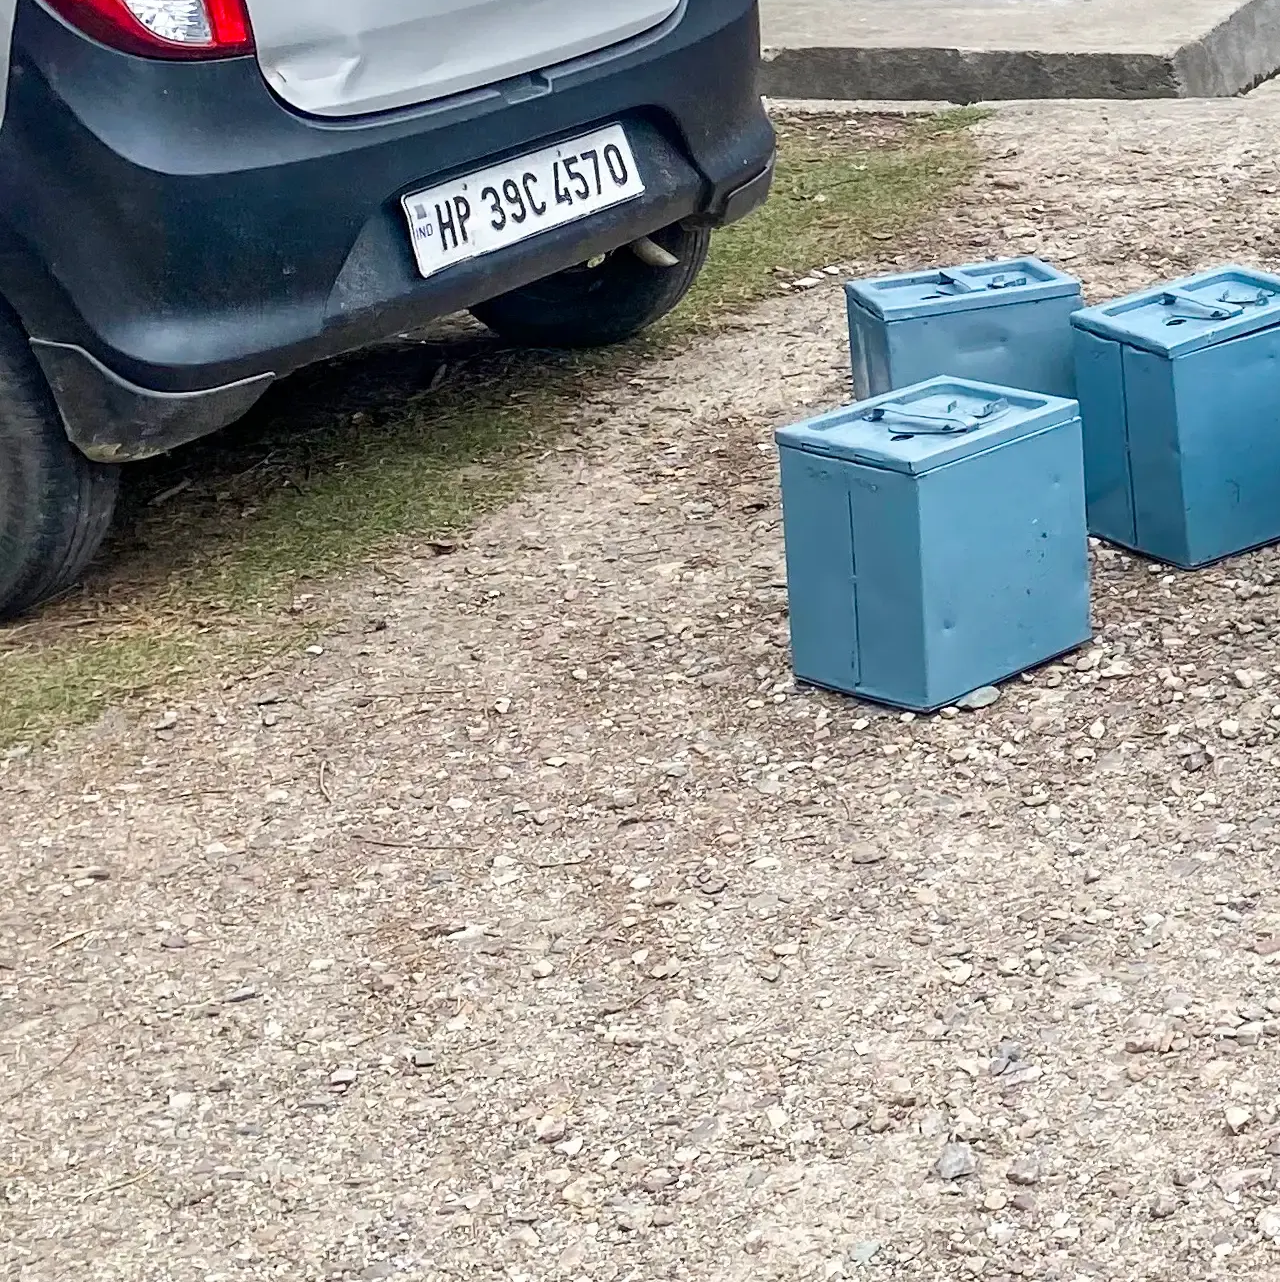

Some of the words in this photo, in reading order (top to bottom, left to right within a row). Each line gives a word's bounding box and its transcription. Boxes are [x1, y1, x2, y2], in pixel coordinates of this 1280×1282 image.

[434, 195, 471, 251] HP
[481, 172, 547, 231] 39C
[553, 144, 629, 206] 4570
[415, 223, 434, 240] IND
